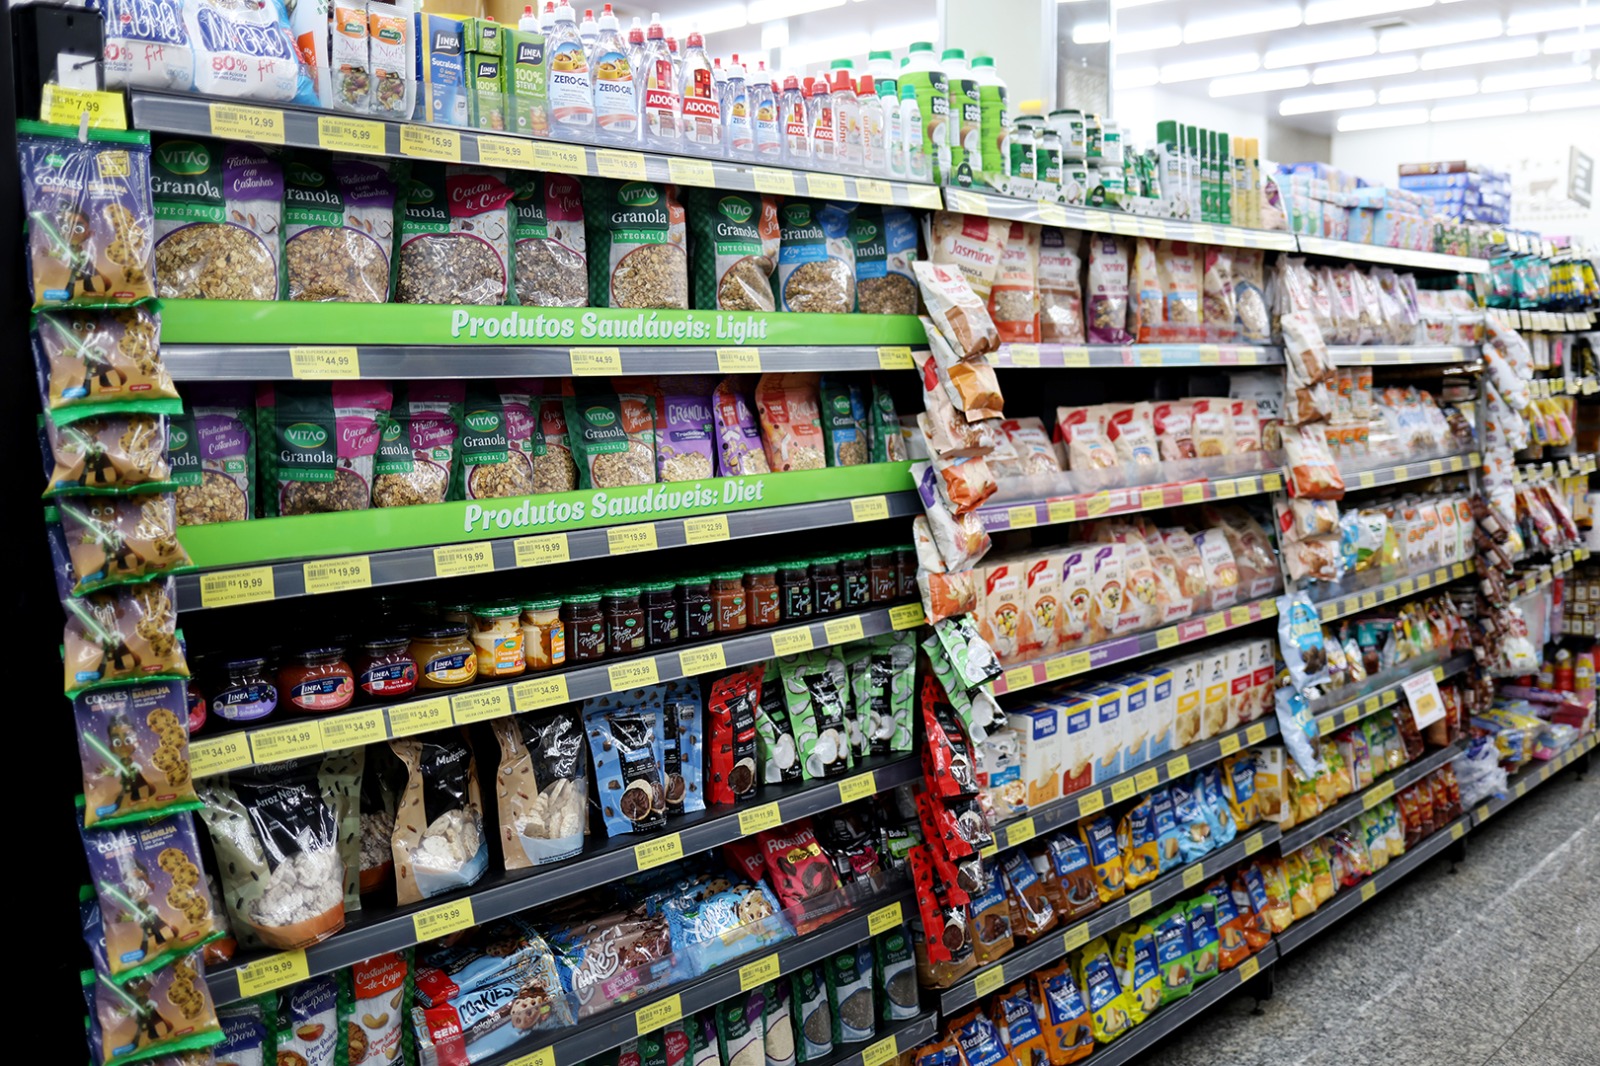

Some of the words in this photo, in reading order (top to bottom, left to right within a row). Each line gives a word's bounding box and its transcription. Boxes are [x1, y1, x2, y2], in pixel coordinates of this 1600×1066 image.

[436, 34, 460, 48] LINEA
[104, 44, 133, 60] 0%
[520, 46, 541, 59] LINEA
[212, 56, 248, 72] 80%
[480, 66, 496, 75] LINEA
[516, 68, 542, 84] 100%
[477, 81, 497, 91] 100%
[516, 81, 536, 90] STEVIA
[76, 100, 100, 112] 7,99
[686, 101, 719, 114] ADOCYL
[249, 116, 274, 128] 12,99
[352, 129, 370, 140] 6,99
[432, 136, 452, 147] 15,99
[505, 147, 521, 156] 8,99
[559, 153, 577, 163] 14,99
[150, 177, 221, 199] Granola
[453, 184, 493, 201] Cacau
[287, 187, 340, 204] ranola
[620, 189, 657, 202] VITAO
[154, 208, 208, 217] NTEGRAL
[611, 211, 667, 224] Granola
[614, 231, 654, 241] INTEGRAL
[717, 224, 759, 239] Granola
[780, 227, 823, 241] Granola
[949, 240, 995, 264] Jasmine
[451, 310, 574, 338] Produtos
[580, 311, 711, 340] Saudáveis:
[716, 316, 768, 345] Light
[325, 357, 349, 366] 44,99
[595, 356, 613, 364] 44,99
[586, 411, 615, 421] VITAO
[668, 404, 712, 424] GRANOLA
[467, 416, 498, 427] VITAO
[287, 430, 326, 442] VITAO
[585, 428, 625, 440] Granola
[463, 437, 506, 448] Granola
[281, 450, 334, 464] Granola
[465, 455, 500, 463] INTEGRAL
[464, 495, 586, 532] Produtos
[590, 485, 718, 518] Saudáveis:
[722, 480, 764, 502] Diet
[707, 523, 722, 531] 22,99
[629, 532, 647, 541] 19,99
[542, 543, 560, 552] 19,99
[464, 552, 484, 562] 19,99
[338, 566, 360, 577] 19,99
[238, 578, 262, 589] 19,99
[792, 633, 806, 643] 29,99
[702, 652, 718, 662] 29,99
[434, 660, 453, 670] LINEA
[633, 666, 650, 676] 29,99
[370, 670, 390, 682] LINEA
[301, 684, 322, 696] LINEA
[540, 684, 560, 695] 34,99
[85, 692, 128, 705] COOKIES
[228, 692, 248, 704] LINEA
[480, 696, 501, 706] 34,99
[418, 708, 439, 719] 34,99
[353, 720, 376, 732] 34,99
[286, 732, 310, 744] 34,99
[211, 744, 237, 757] 34,99
[256, 794, 280, 808] Arroz
[277, 784, 306, 800] Negro
[760, 810, 774, 818] 11,99
[767, 826, 814, 854] Rosquin
[658, 842, 675, 852] 11,99
[444, 909, 460, 920] 9,99
[274, 960, 292, 974] 9,99
[356, 960, 398, 982] Castanha-
[759, 964, 771, 973] 6,99
[659, 1006, 671, 1016] 7,99
[434, 1025, 458, 1039] SEM
